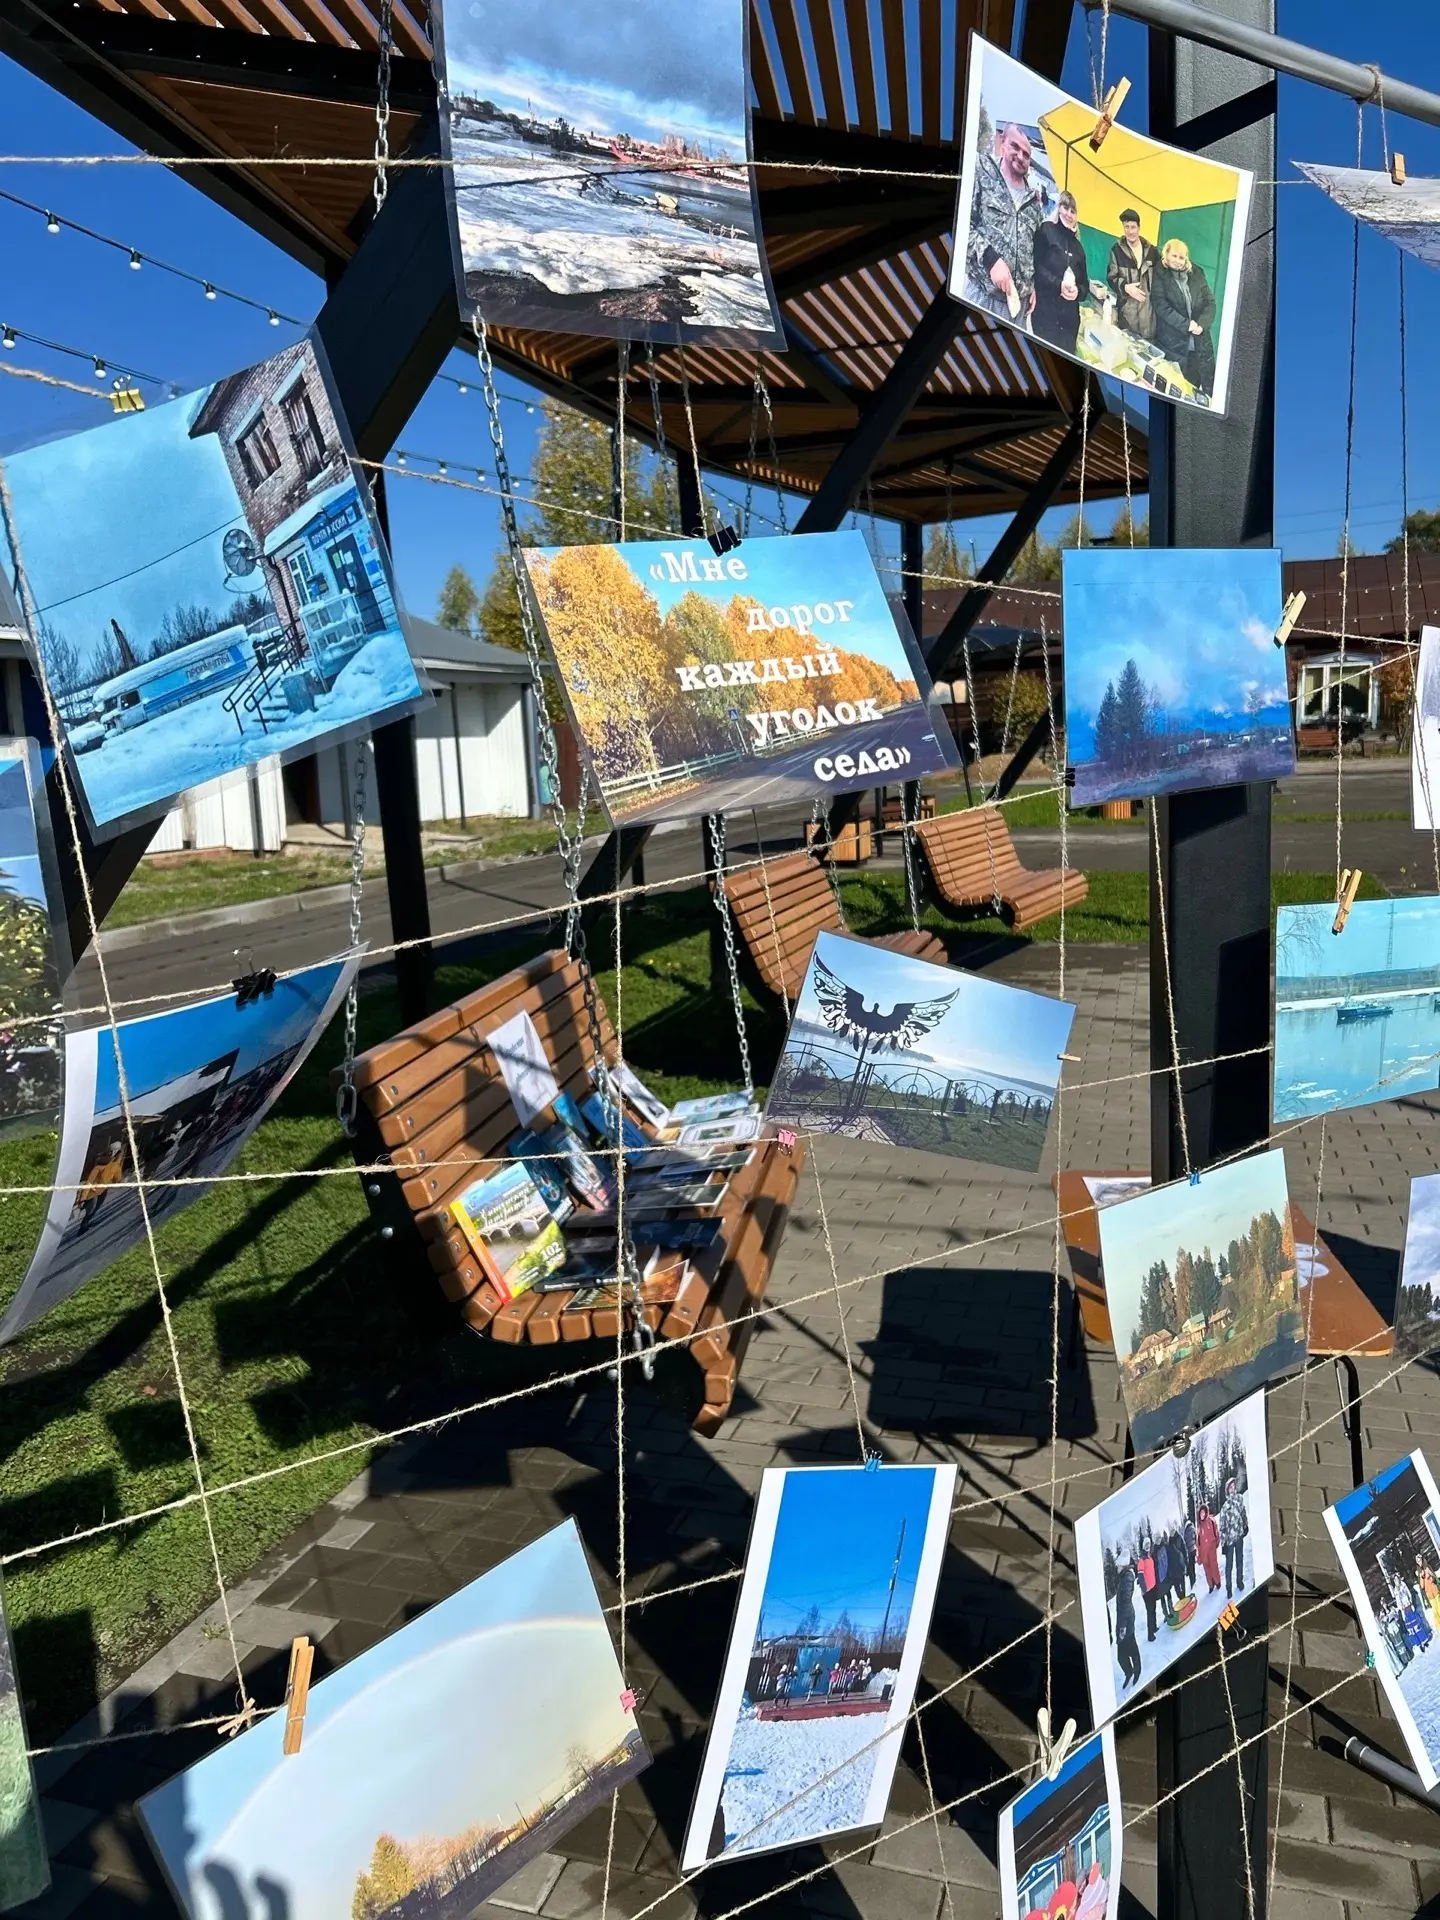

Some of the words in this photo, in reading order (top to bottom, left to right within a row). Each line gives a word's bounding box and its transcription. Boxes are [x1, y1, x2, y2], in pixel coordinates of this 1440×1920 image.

[649, 551, 748, 582] «Мне
[746, 600, 854, 636] дорог
[675, 642, 843, 691] каждый
[746, 698, 884, 747] уголок
[813, 746, 911, 782] села»
[540, 1241, 562, 1262] 102
